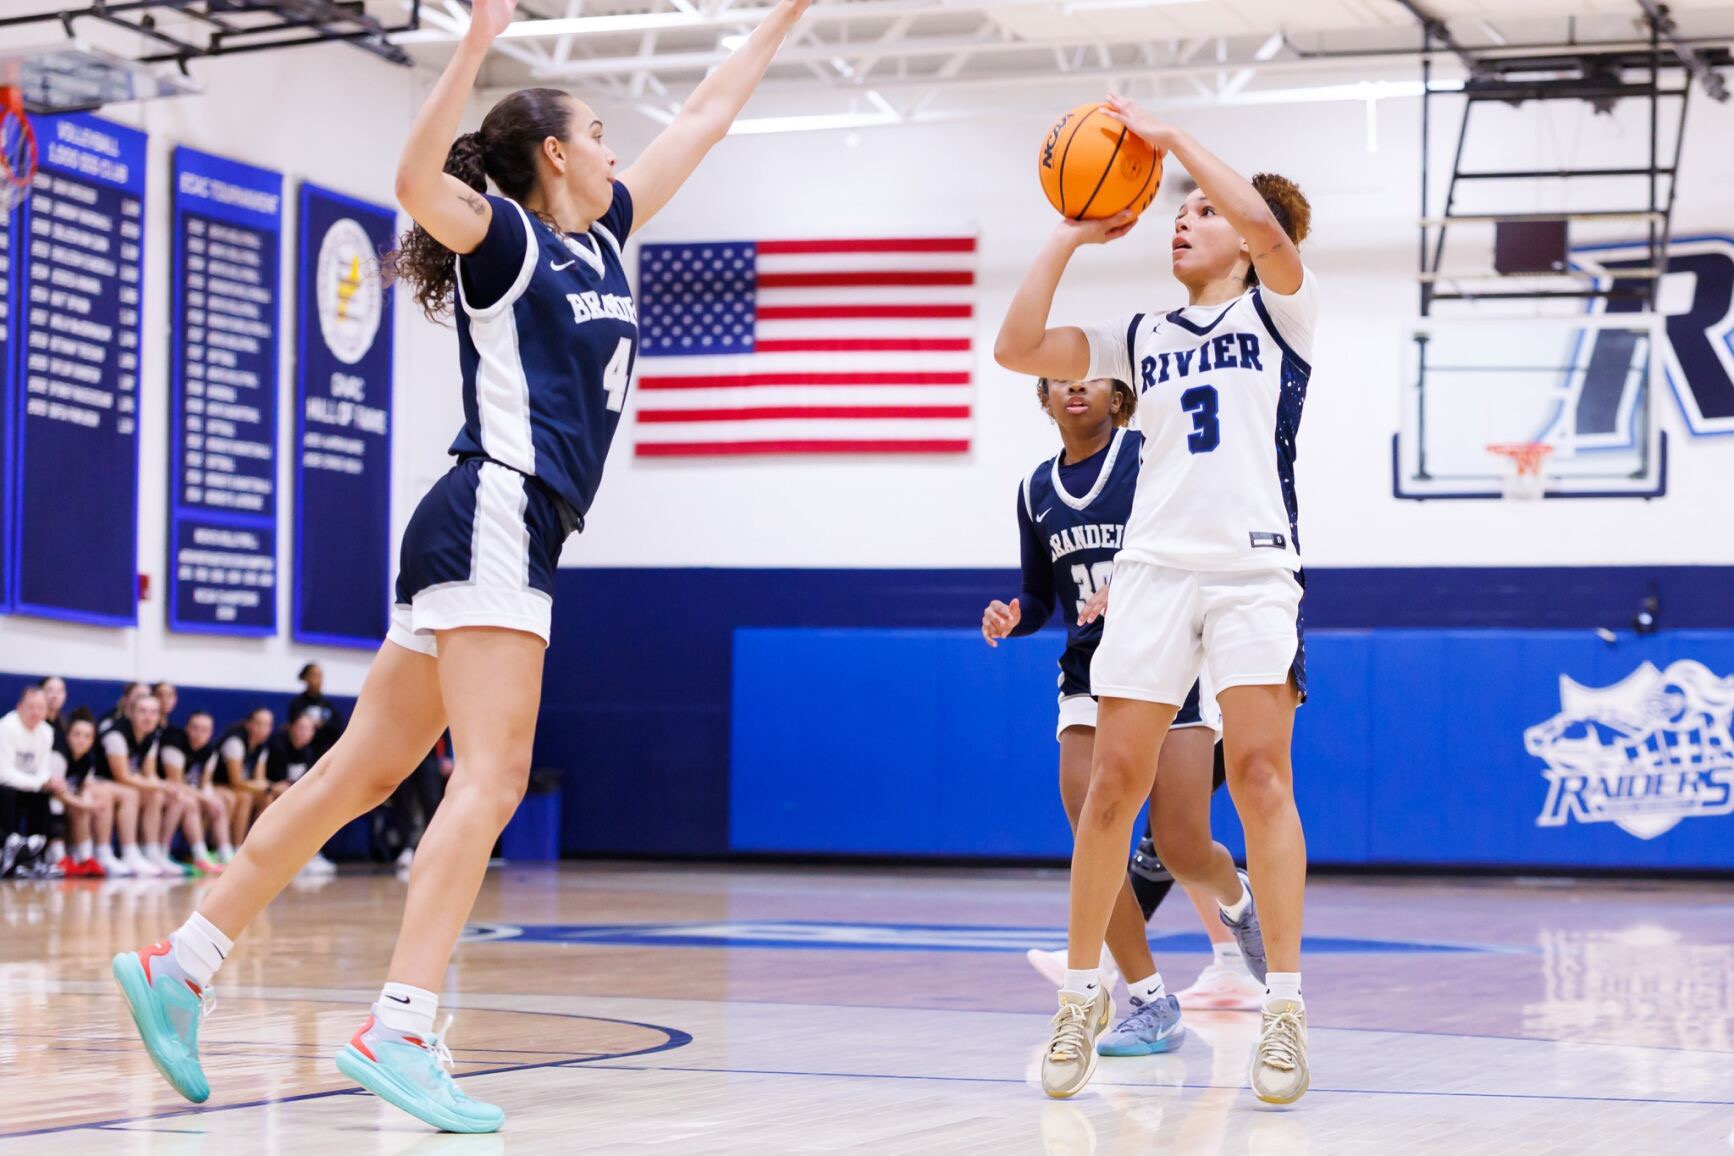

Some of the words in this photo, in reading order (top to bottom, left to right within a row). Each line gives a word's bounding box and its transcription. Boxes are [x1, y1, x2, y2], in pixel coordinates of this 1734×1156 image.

[566, 290, 638, 328] BRANDE
[603, 336, 632, 413] 4
[1141, 333, 1263, 395] RIVIER
[1180, 384, 1220, 455] 3
[1050, 524, 1124, 563] RANDEI
[1536, 766, 1734, 828] RAIDERS
